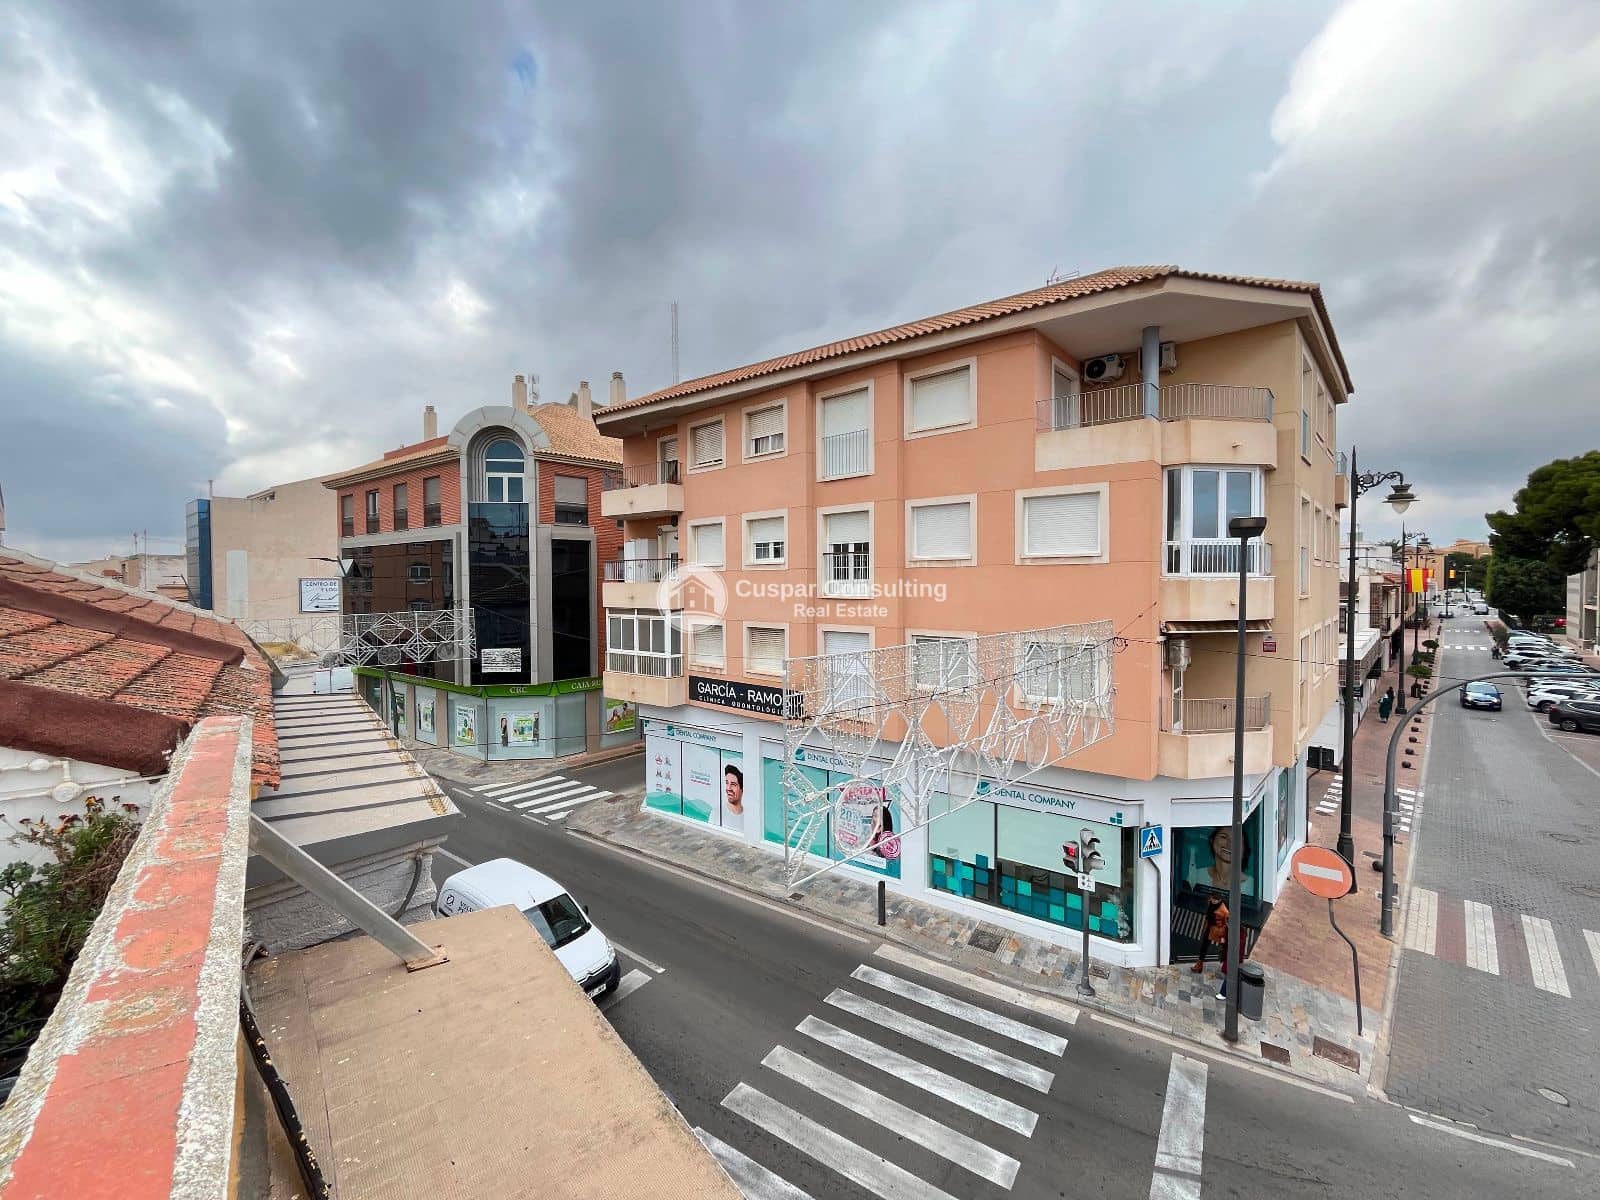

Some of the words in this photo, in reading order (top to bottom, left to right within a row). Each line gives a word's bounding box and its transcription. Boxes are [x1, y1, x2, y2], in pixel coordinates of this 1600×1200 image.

[697, 681, 736, 699] GARCÍA
[747, 689, 785, 707] RAMO
[675, 729, 692, 738] DENTAL
[692, 732, 717, 741] COMPANY
[994, 787, 1026, 801] DENTAL
[1028, 793, 1076, 810] COMPANY
